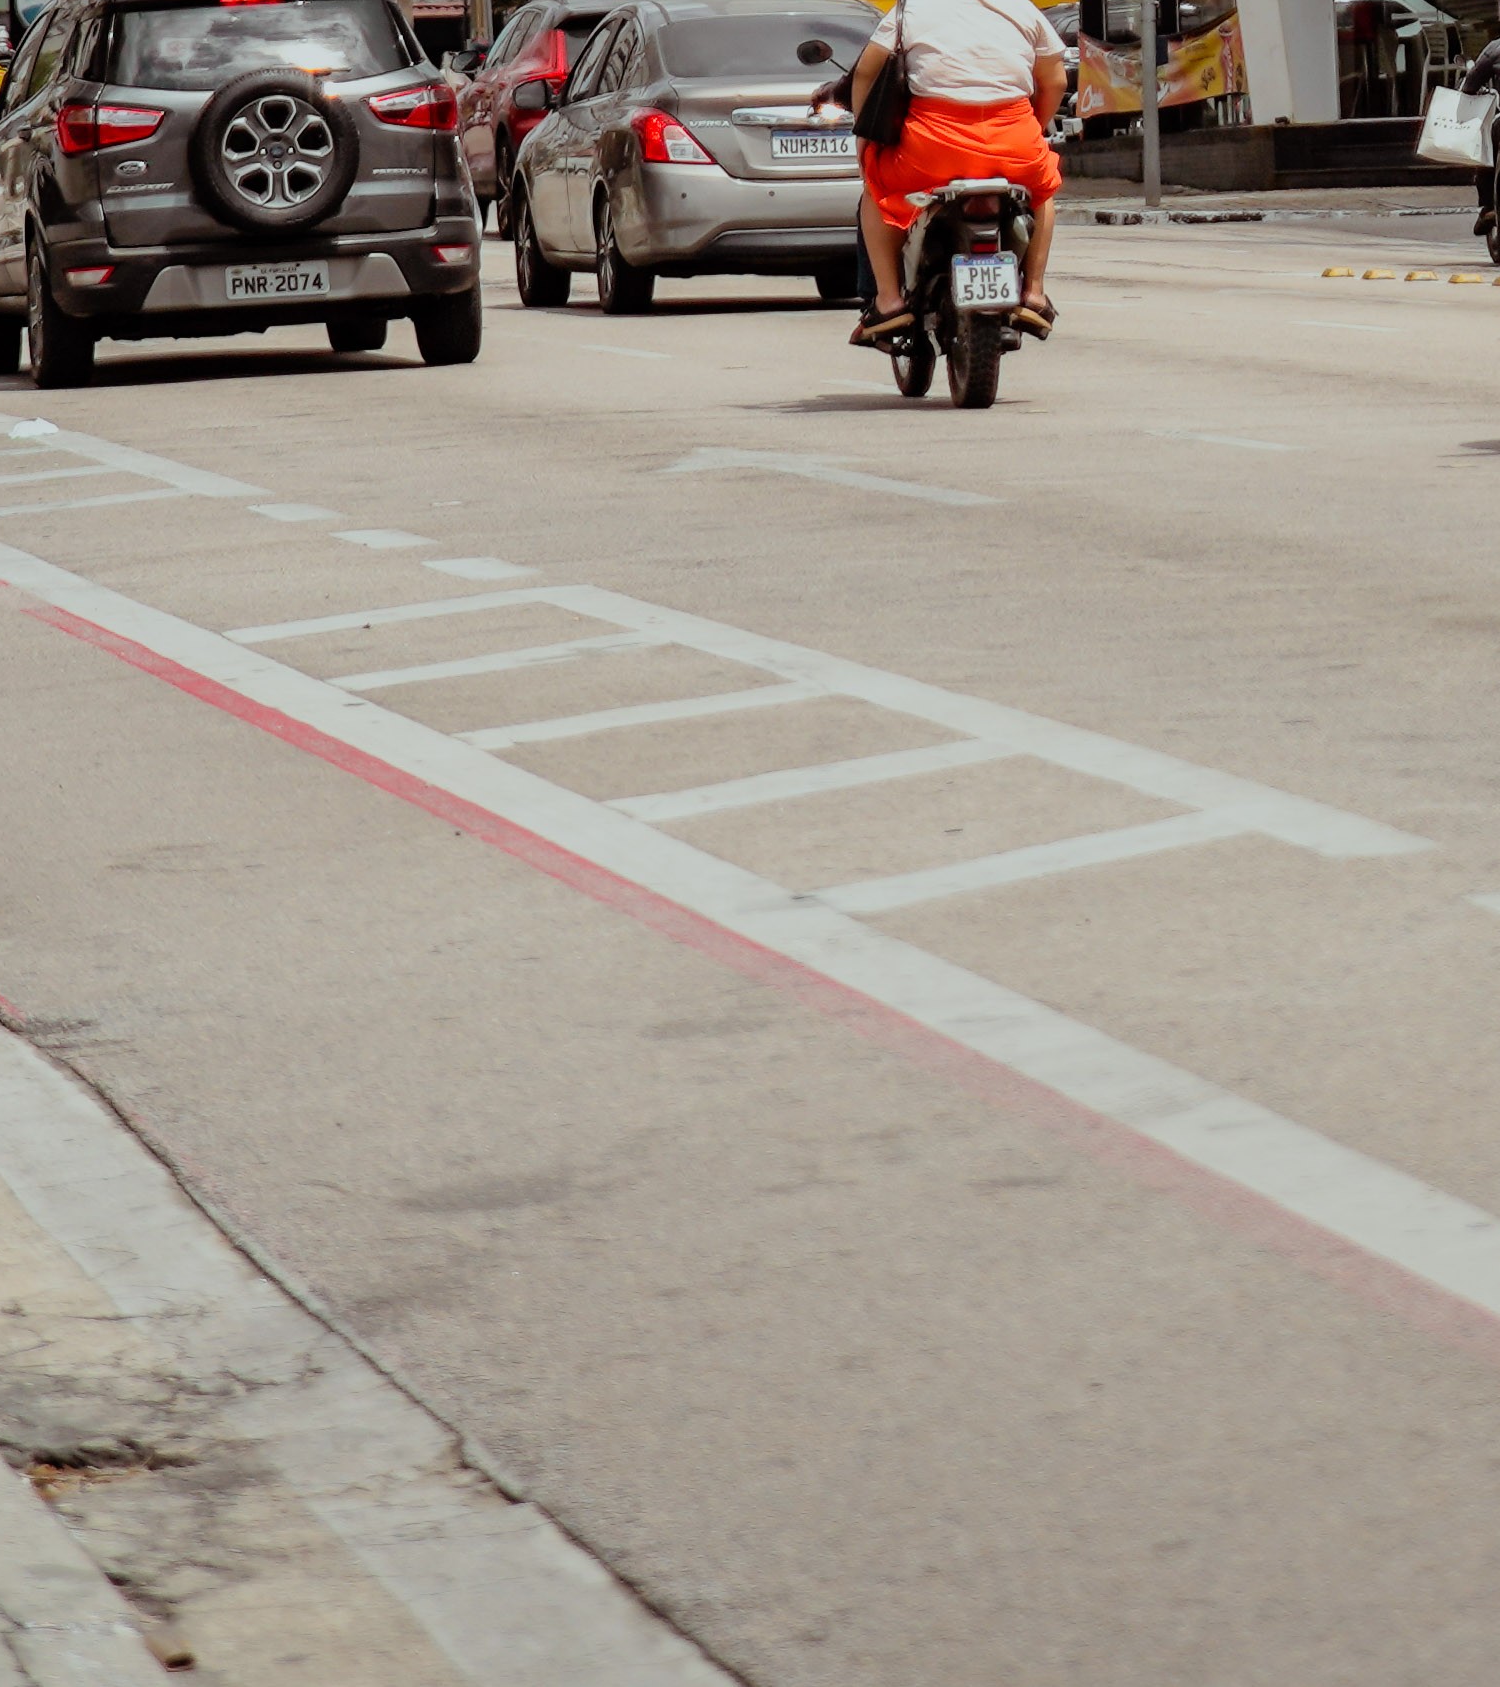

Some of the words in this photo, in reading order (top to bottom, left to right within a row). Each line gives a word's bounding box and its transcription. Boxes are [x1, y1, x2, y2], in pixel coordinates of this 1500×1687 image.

[689, 120, 731, 128] VERSA
[779, 138, 849, 153] NUH3A16
[969, 267, 1002, 283] PMF
[964, 283, 1009, 301] 5J56
